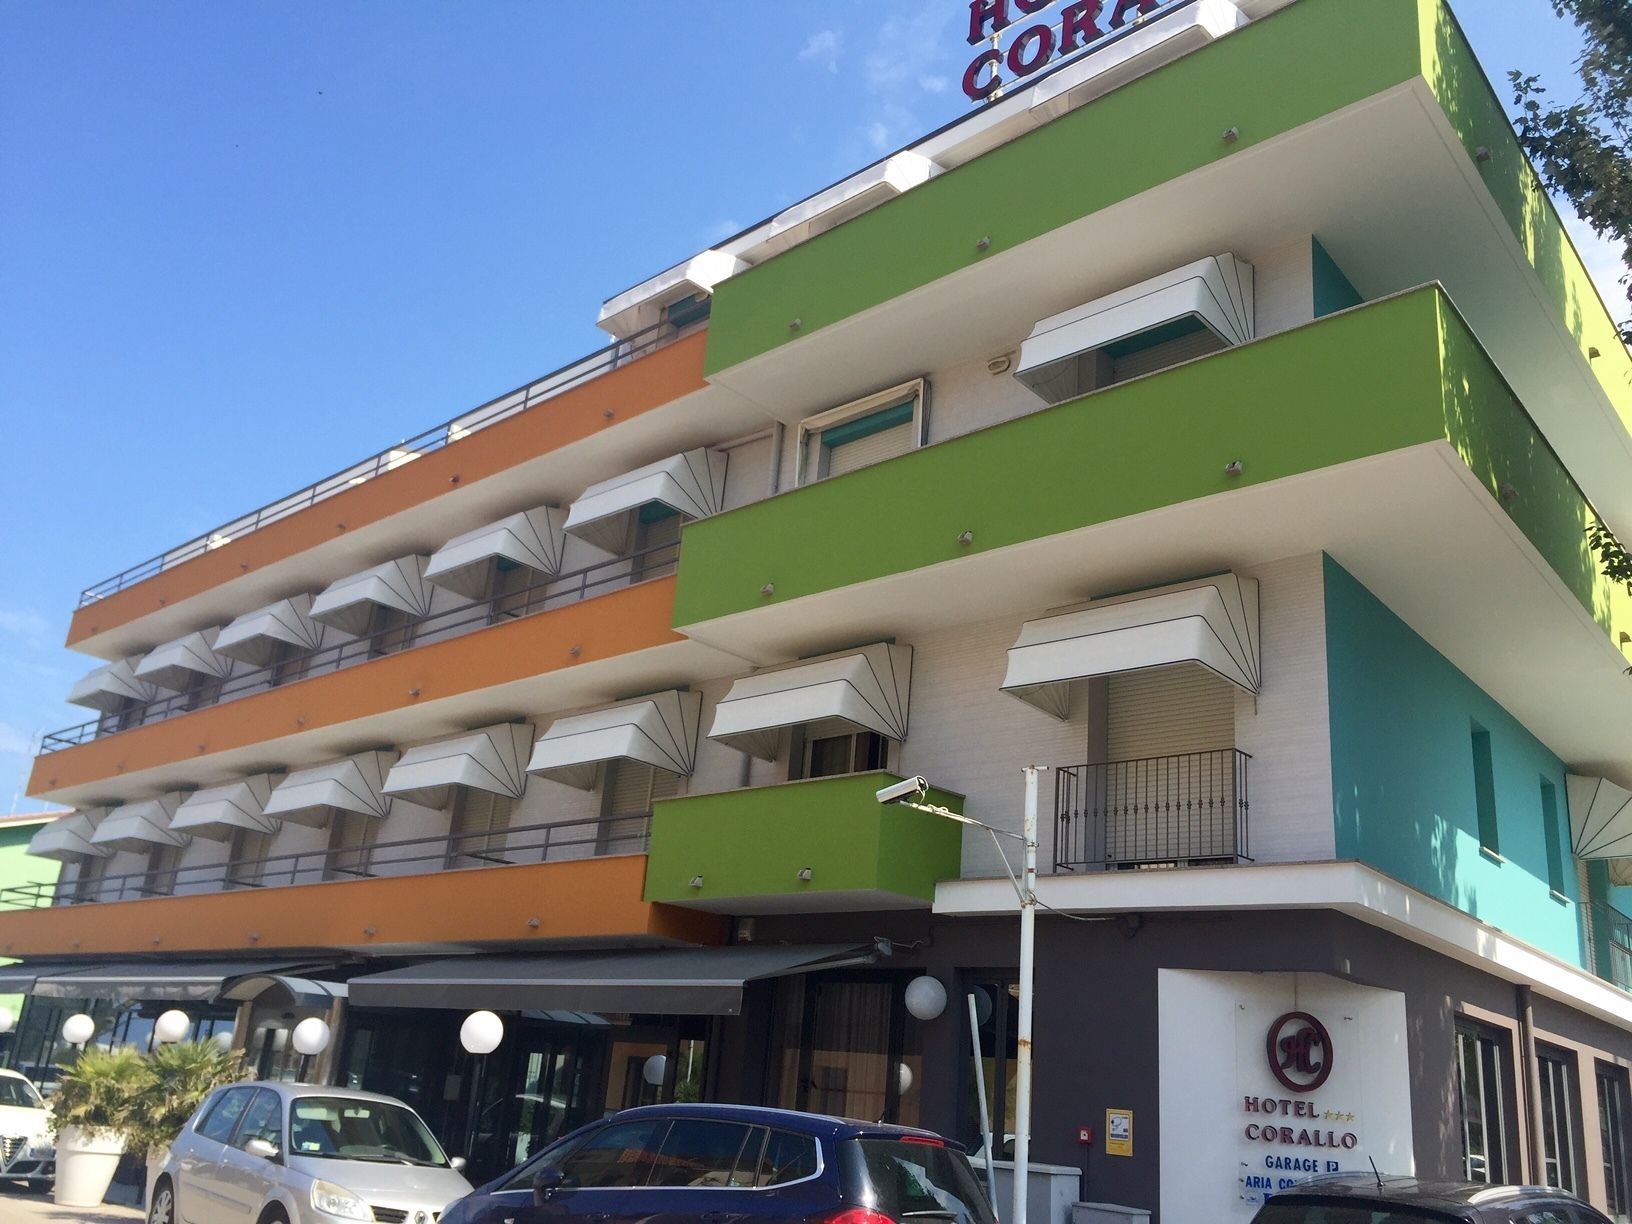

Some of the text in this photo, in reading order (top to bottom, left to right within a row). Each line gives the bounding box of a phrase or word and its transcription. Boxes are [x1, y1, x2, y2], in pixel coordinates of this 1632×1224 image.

[1244, 1096, 1320, 1119] HOTEL
[1245, 1123, 1358, 1149] CORALLO
[1265, 1155, 1318, 1172] GARAGE
[1246, 1176, 1297, 1190] ARIA CO
